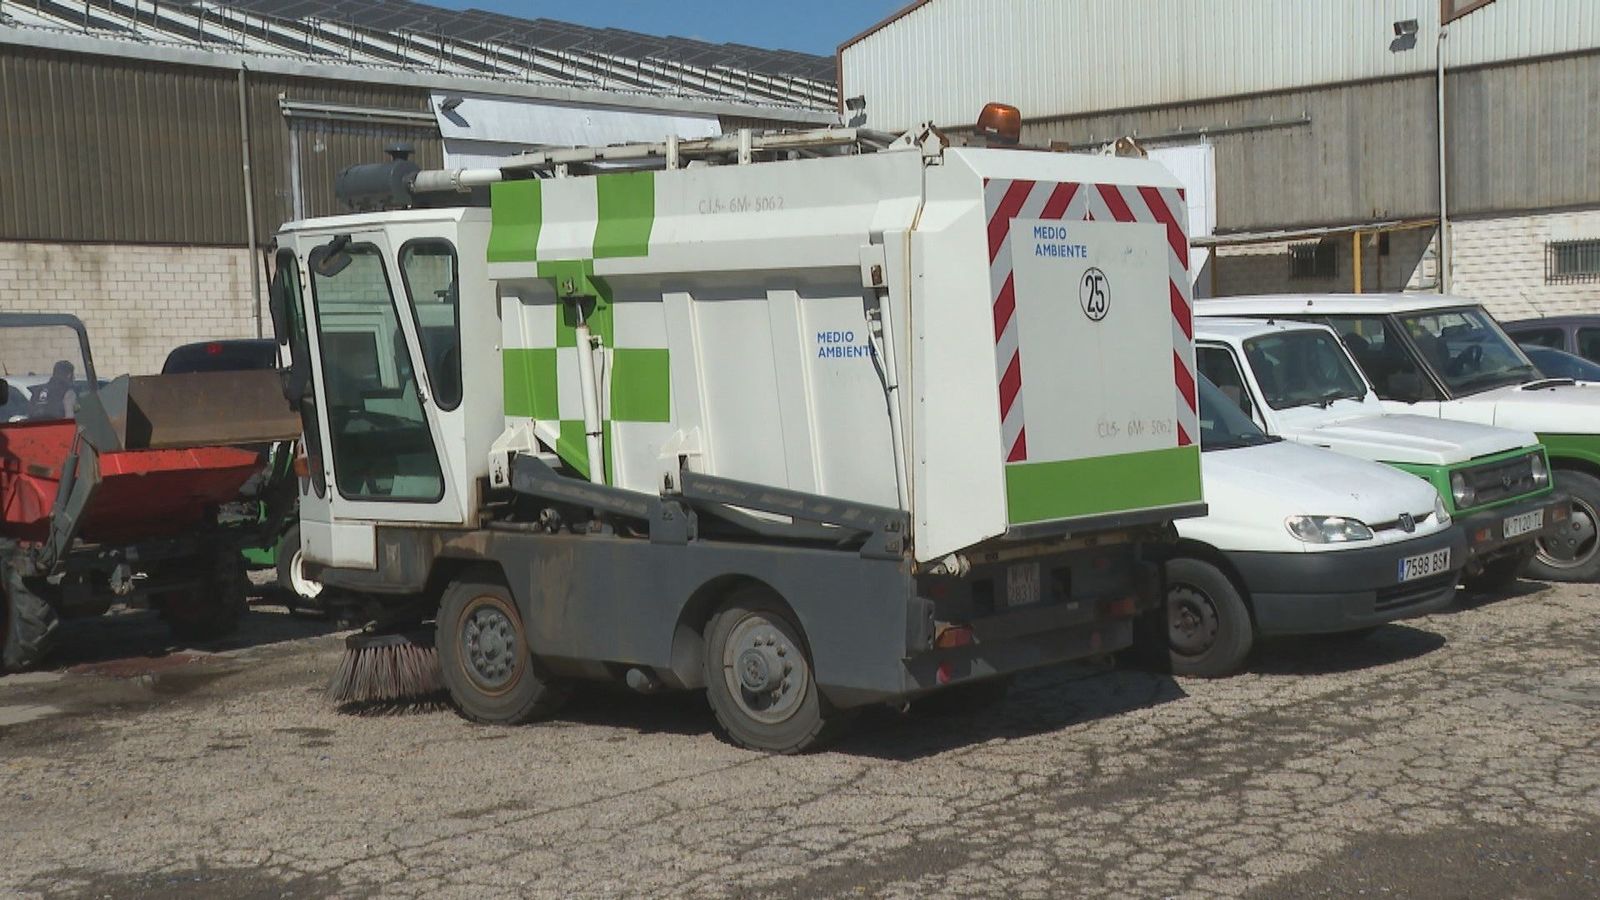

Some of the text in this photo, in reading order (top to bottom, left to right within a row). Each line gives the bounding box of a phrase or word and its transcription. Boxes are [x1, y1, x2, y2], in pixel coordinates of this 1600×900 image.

[1034, 226, 1067, 240] MEDIO
[1035, 243, 1087, 258] AMBIENTE
[1085, 274, 1105, 313] 25
[817, 331, 854, 344] MEDIO
[818, 345, 876, 359] AMBIENT
[1406, 551, 1448, 579] 7598 BSW
